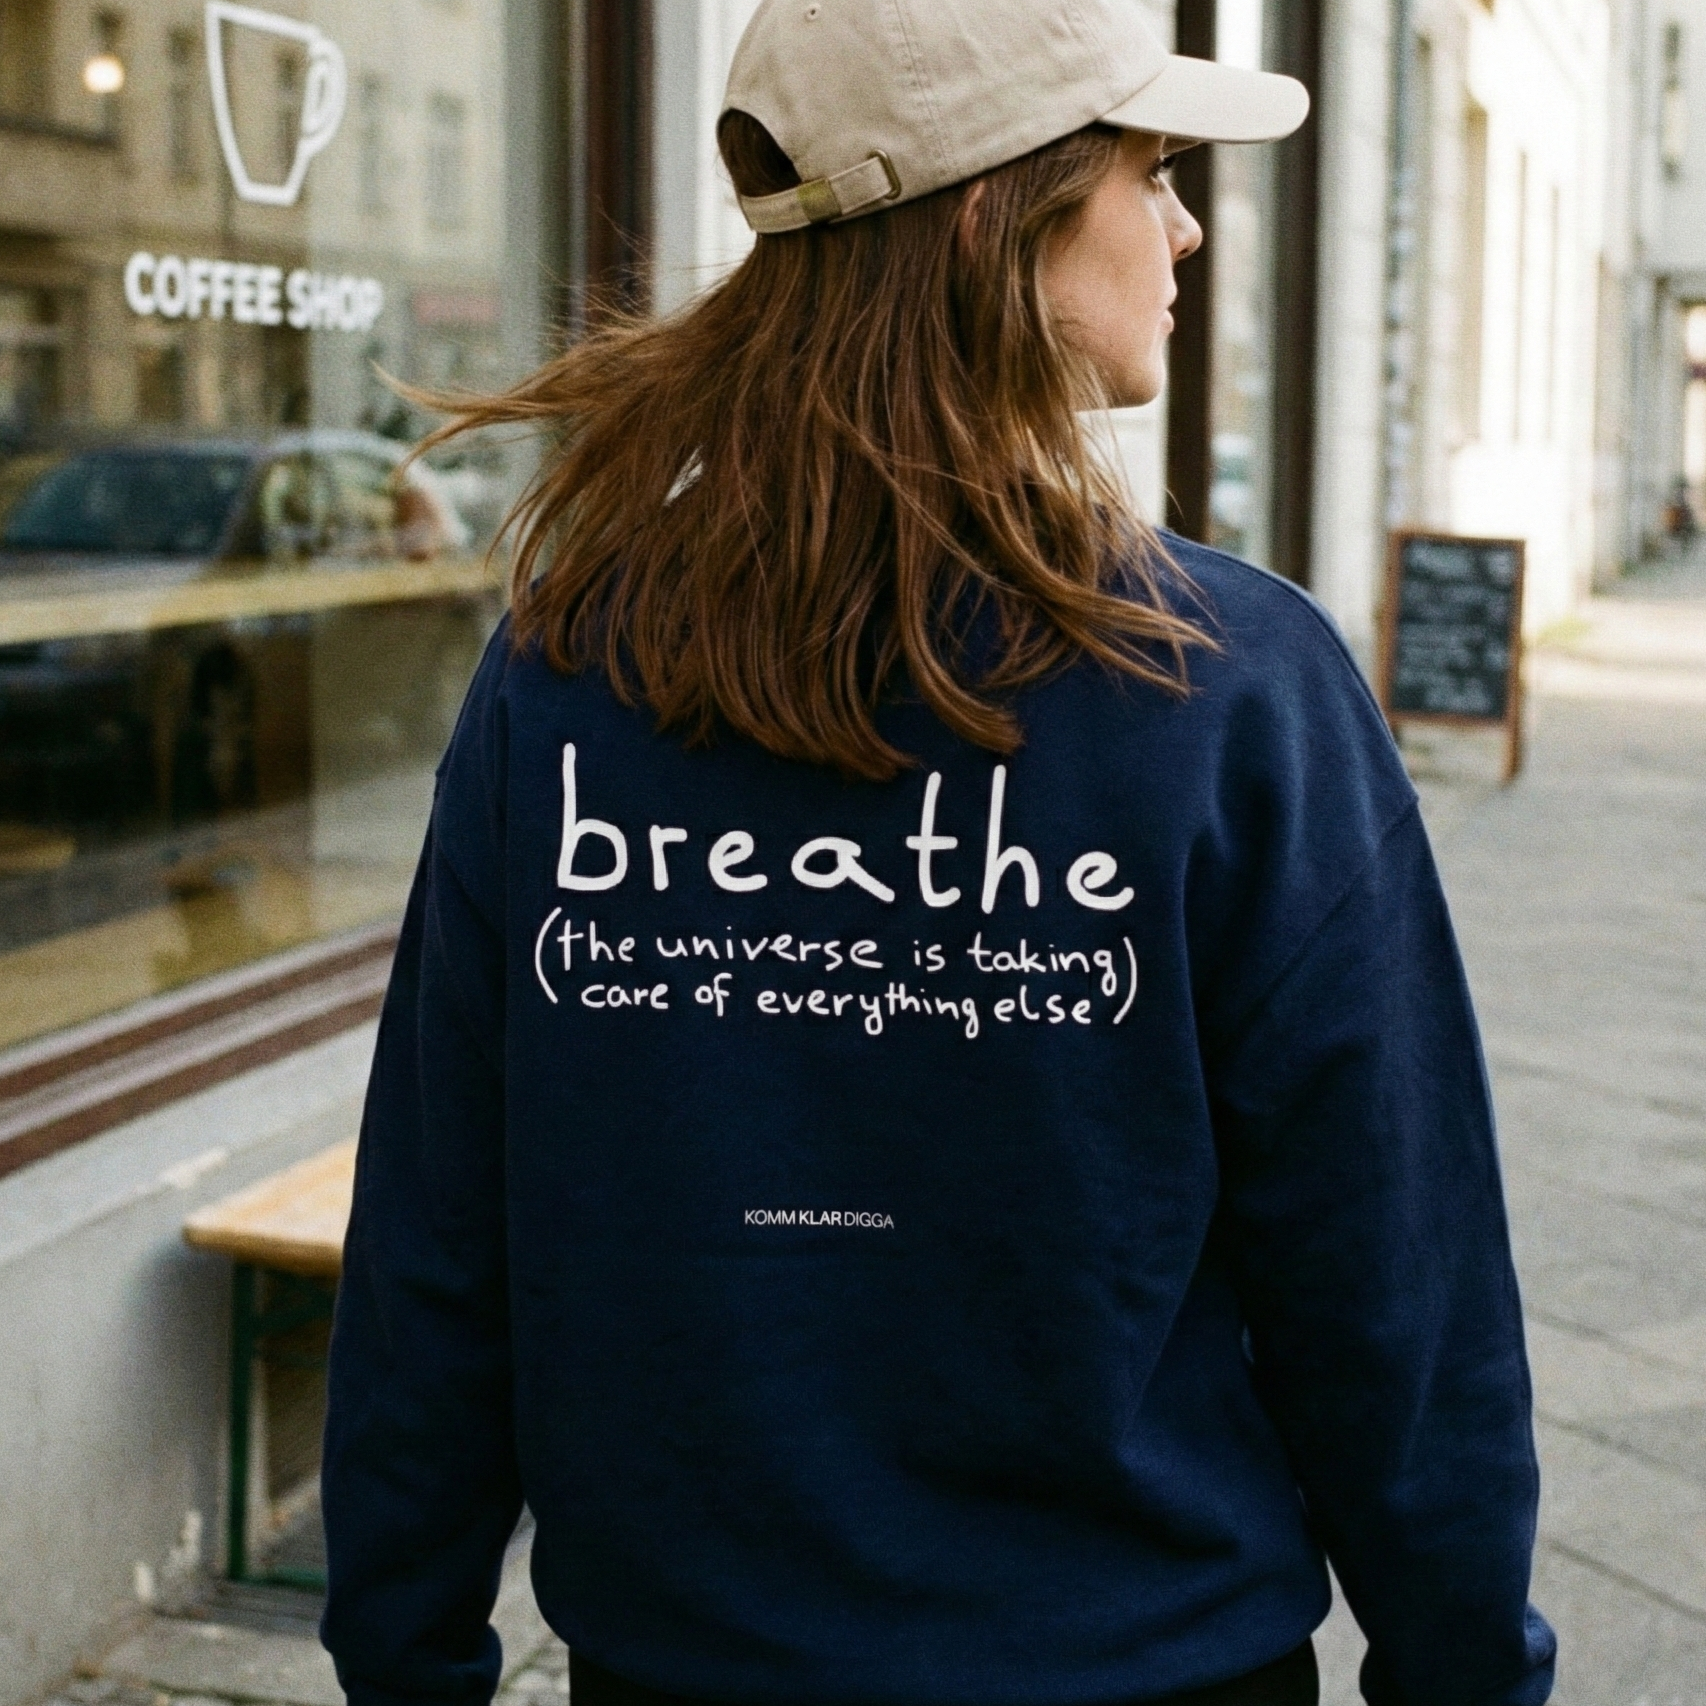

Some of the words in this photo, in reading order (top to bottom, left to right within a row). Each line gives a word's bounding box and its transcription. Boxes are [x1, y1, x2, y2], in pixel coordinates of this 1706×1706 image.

[124, 252, 284, 326] COFFEE
[285, 269, 383, 332] SHOP
[556, 742, 1135, 915] breathe
[656, 926, 884, 972] universe
[913, 943, 944, 972] is
[580, 983, 669, 1010] care
[694, 972, 733, 1017] of
[756, 981, 979, 1039] everything
[744, 1209, 796, 1226] KOMM
[799, 1210, 842, 1227] KLAR
[844, 1211, 895, 1229] DIGGA
